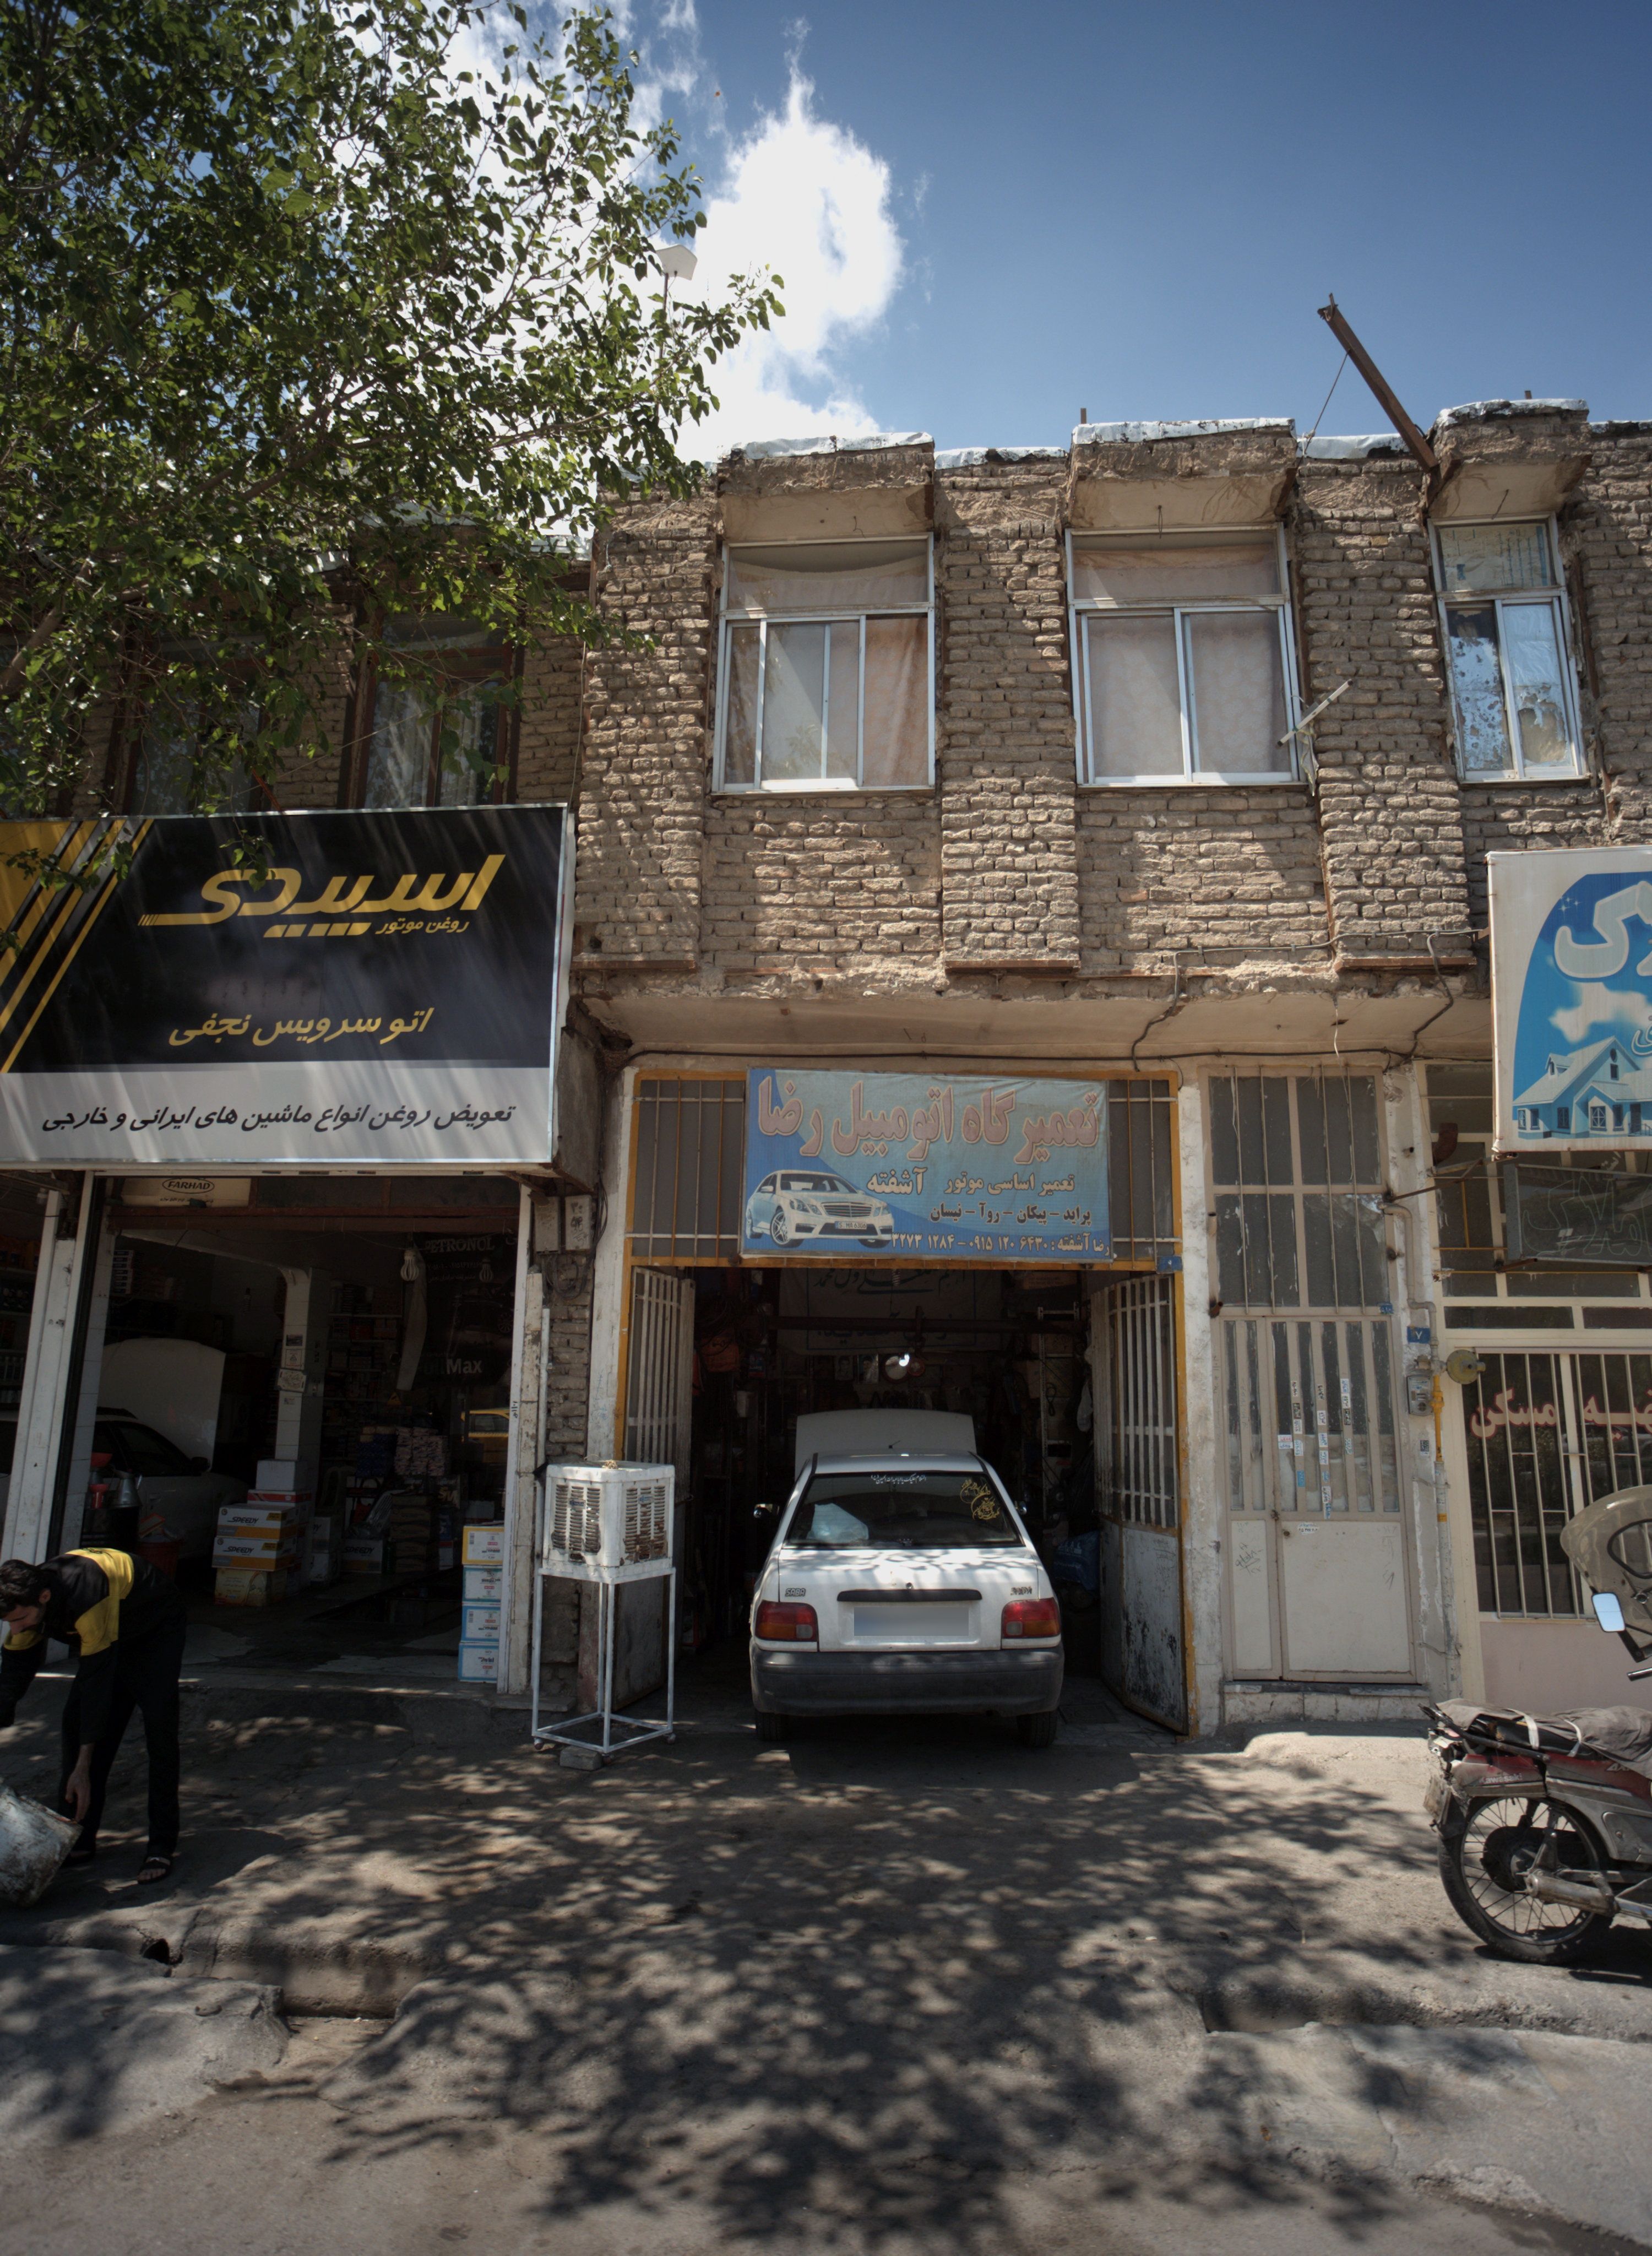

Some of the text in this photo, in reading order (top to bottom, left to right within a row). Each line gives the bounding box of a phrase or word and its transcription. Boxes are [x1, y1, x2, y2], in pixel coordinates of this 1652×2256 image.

[375, 917, 470, 935] روغن موتور
[169, 1007, 434, 1046] اتو سرویس نجفی
[42, 1103, 517, 1132] تعویض روغن انواع ماشین های ایرانی و خارجی
[758, 1076, 824, 1157] رضا
[831, 1080, 954, 1161] اتومبیل
[167, 1181, 210, 1190] FARHAD
[866, 1166, 1075, 1196] تعمیر اساسی موتور آشفته
[930, 1202, 962, 1222] نیسان
[1017, 1204, 1047, 1224] پیکان
[1063, 1205, 1091, 1225] پراید
[892, 1232, 922, 1249] ۳۲۷۳
[928, 1234, 955, 1250] ۱۲۸۴
[969, 1234, 993, 1252] ۰۹۱۵
[998, 1235, 1015, 1251] ۱۲۰
[1020, 1236, 1048, 1252] ۶۴۳۰
[1093, 1238, 1111, 1256] رضا
[1470, 1387, 1557, 1440] مسکن
[785, 1588, 806, 1597] SABA
[1479, 1772, 1523, 1784] Kawasaki
